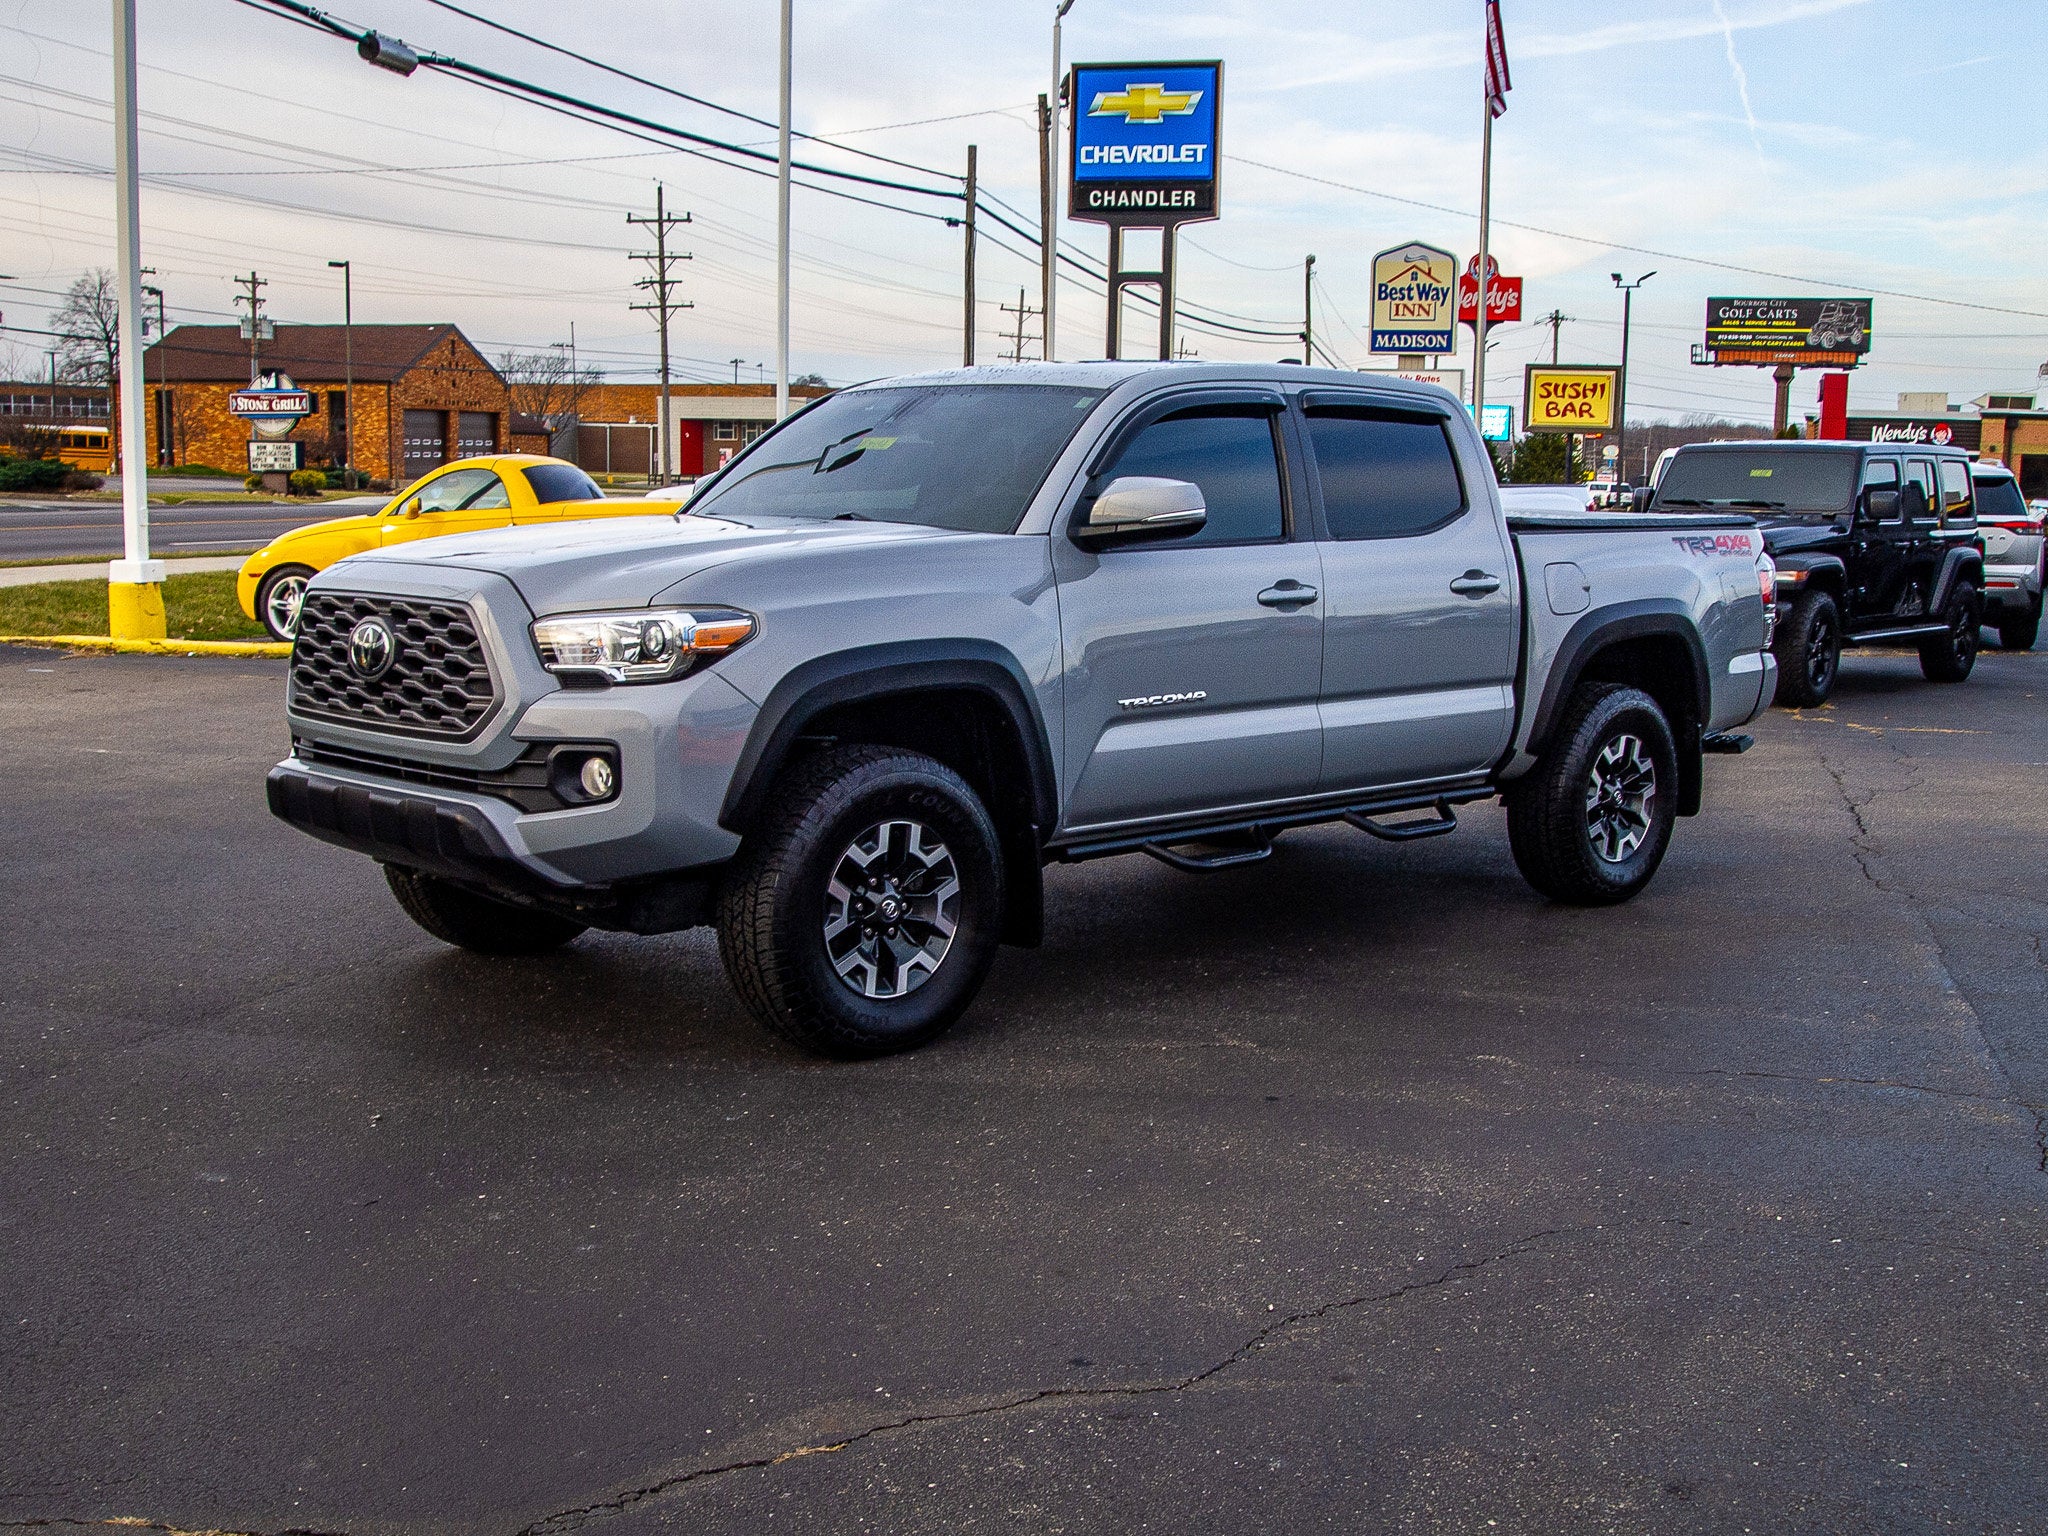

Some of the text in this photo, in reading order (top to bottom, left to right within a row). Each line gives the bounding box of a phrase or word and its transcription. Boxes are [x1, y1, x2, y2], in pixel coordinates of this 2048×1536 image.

[1080, 144, 1208, 164] CHEVROLET
[1089, 190, 1196, 207] CHANDLER
[1393, 303, 1432, 317] INN
[1719, 306, 1798, 319] GOLF CARTS
[1375, 334, 1448, 348] MADISON
[1415, 374, 1440, 383] Rates
[1539, 382, 1606, 399] SUSHI
[237, 397, 302, 411] STONE GRILL
[1545, 401, 1595, 418] BAR
[1871, 422, 1927, 444] Wendy's
[1118, 691, 1207, 706] TACOMA
